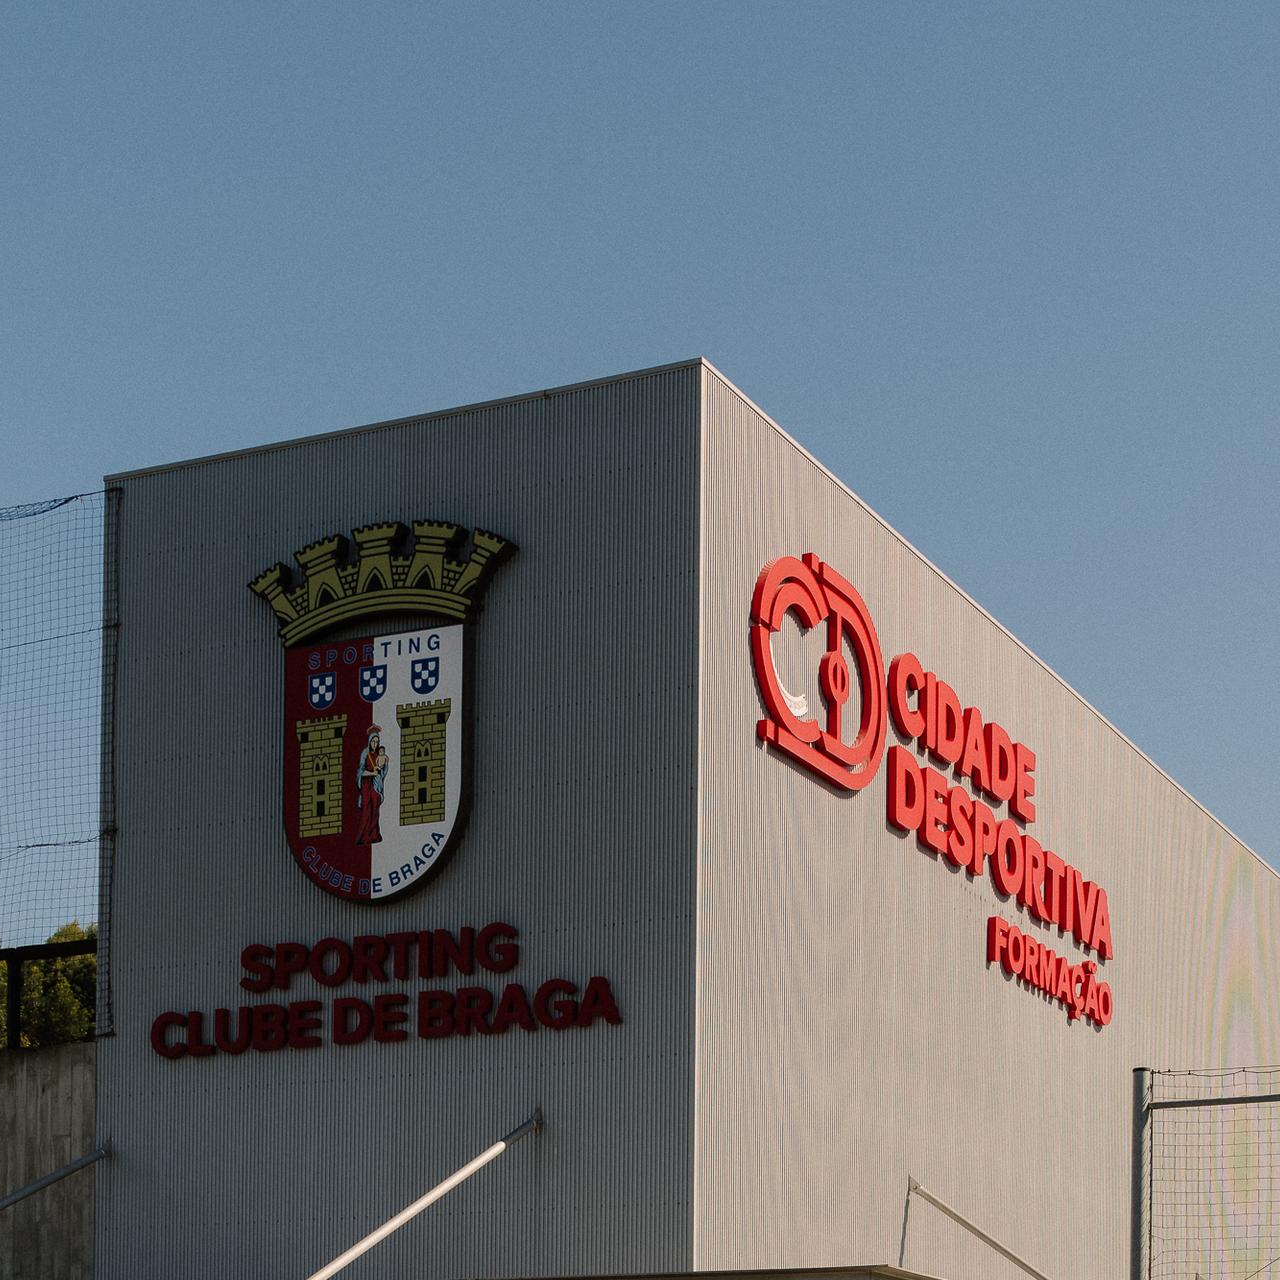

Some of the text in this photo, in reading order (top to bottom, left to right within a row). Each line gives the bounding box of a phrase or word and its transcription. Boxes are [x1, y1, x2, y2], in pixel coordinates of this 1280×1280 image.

[307, 633, 442, 671] SPORTING
[887, 652, 1036, 824] CIDADE
[302, 830, 446, 895] CLUBE DE BRAGA
[886, 744, 1114, 961] DESPORTIVA
[239, 921, 521, 994] SPORTING
[985, 915, 1114, 1027] FORMAÇÃO
[150, 975, 624, 1060] CLUBE DE BRAGA
